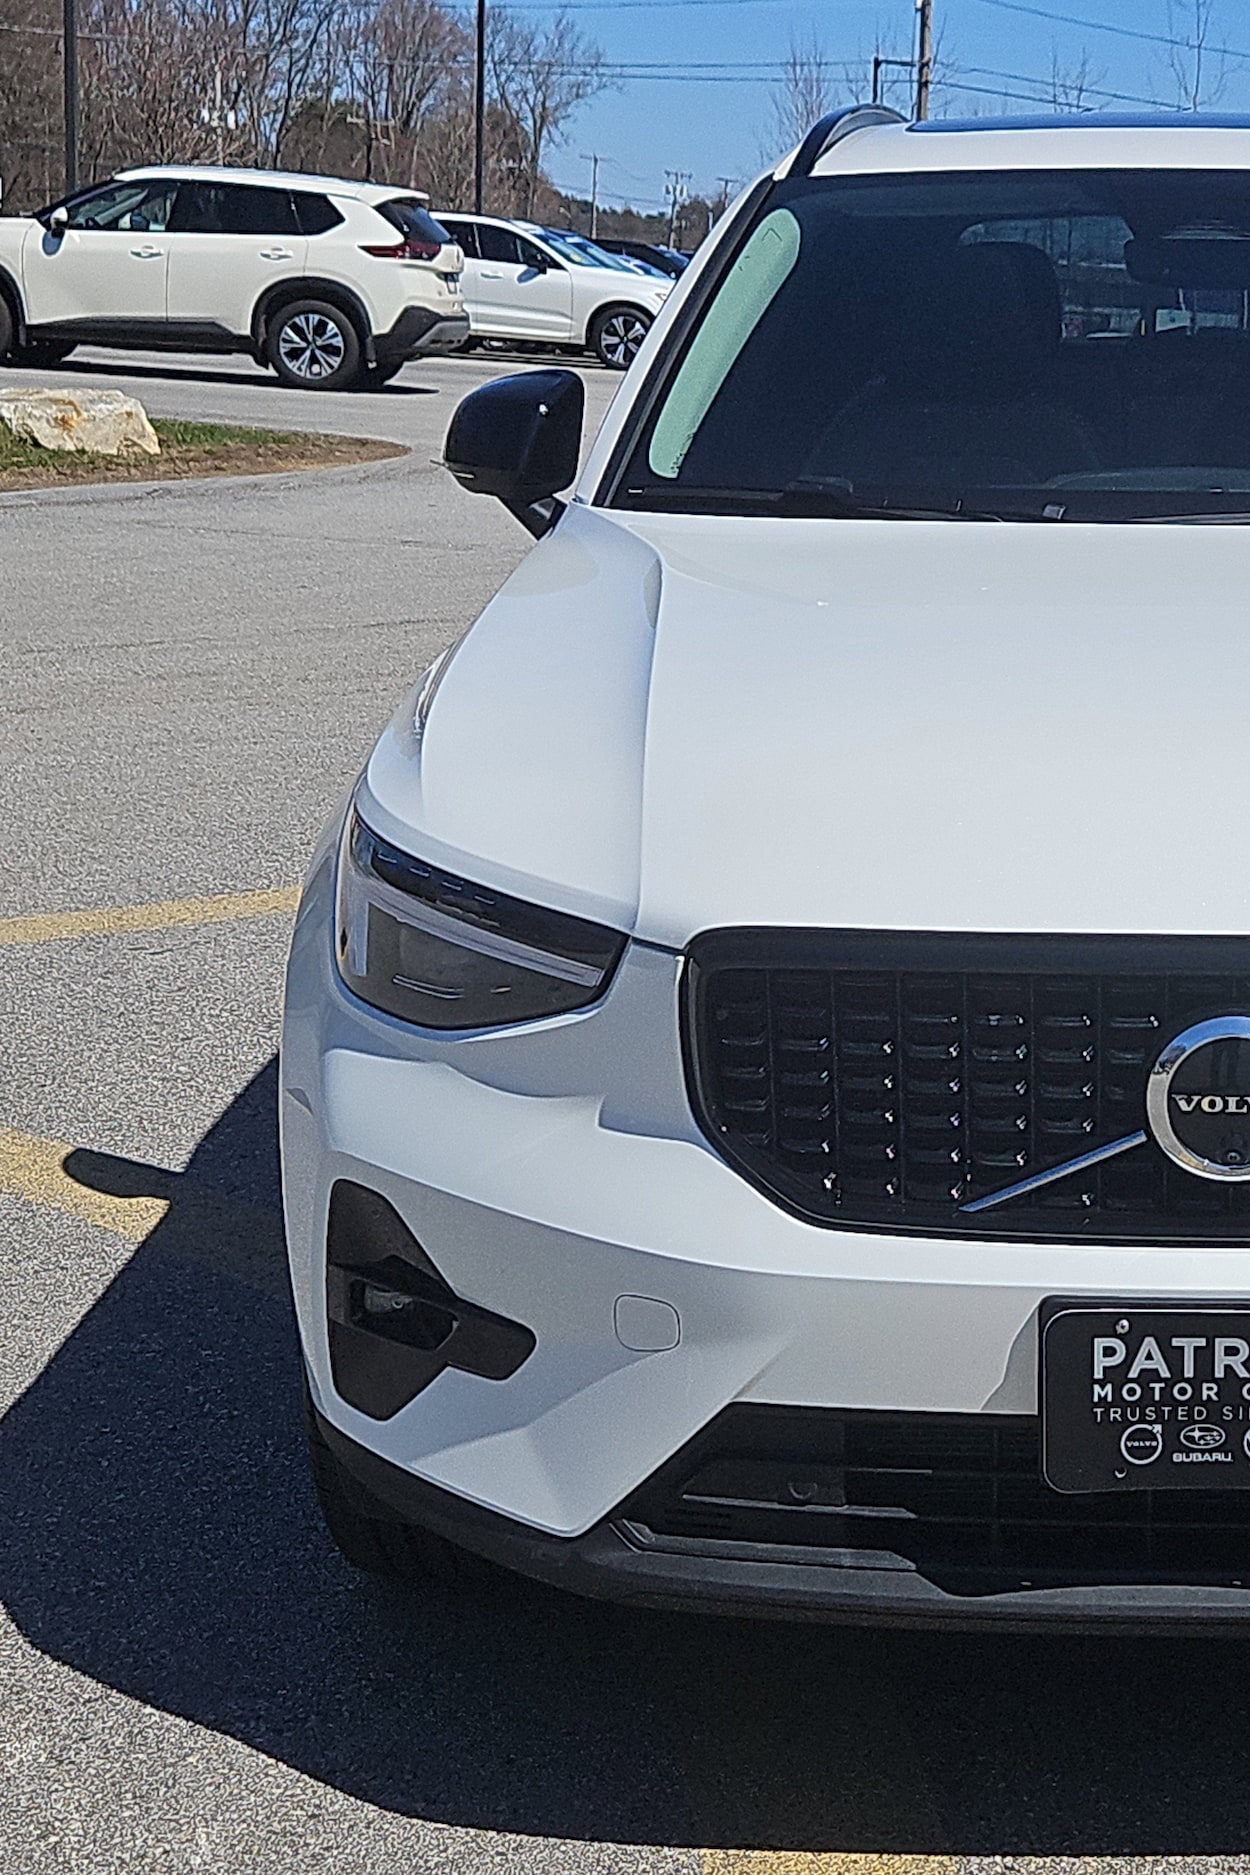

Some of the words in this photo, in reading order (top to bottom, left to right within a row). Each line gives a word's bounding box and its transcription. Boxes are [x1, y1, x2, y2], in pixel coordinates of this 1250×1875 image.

[1093, 1383, 1219, 1402] MOTOR
[1094, 1406, 1207, 1422] TRUSTED
[1172, 1452, 1232, 1463] SUBARU
